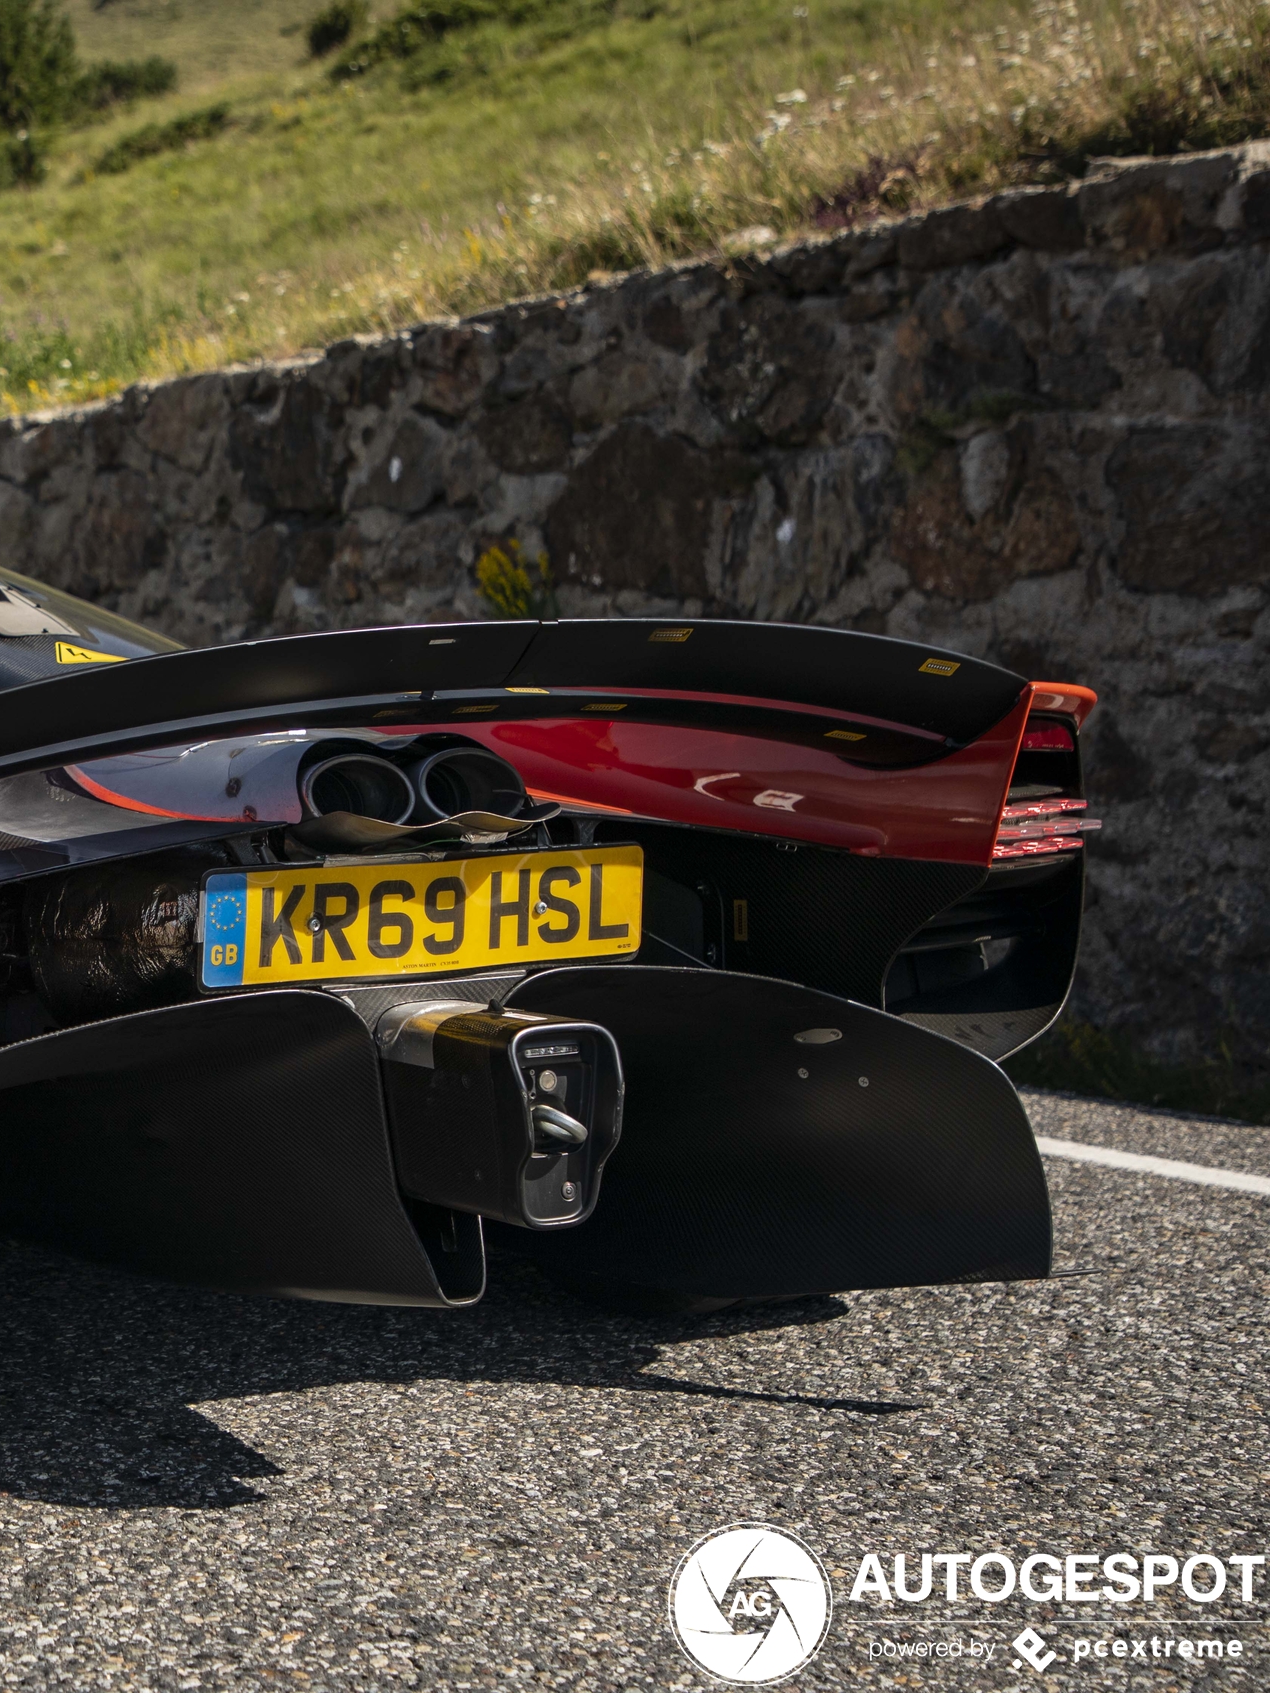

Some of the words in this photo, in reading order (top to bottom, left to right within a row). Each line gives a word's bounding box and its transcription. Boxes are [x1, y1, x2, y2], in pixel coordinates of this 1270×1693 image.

[258, 876, 465, 968] KR69
[488, 864, 629, 949] HSL
[210, 943, 238, 966] GB
